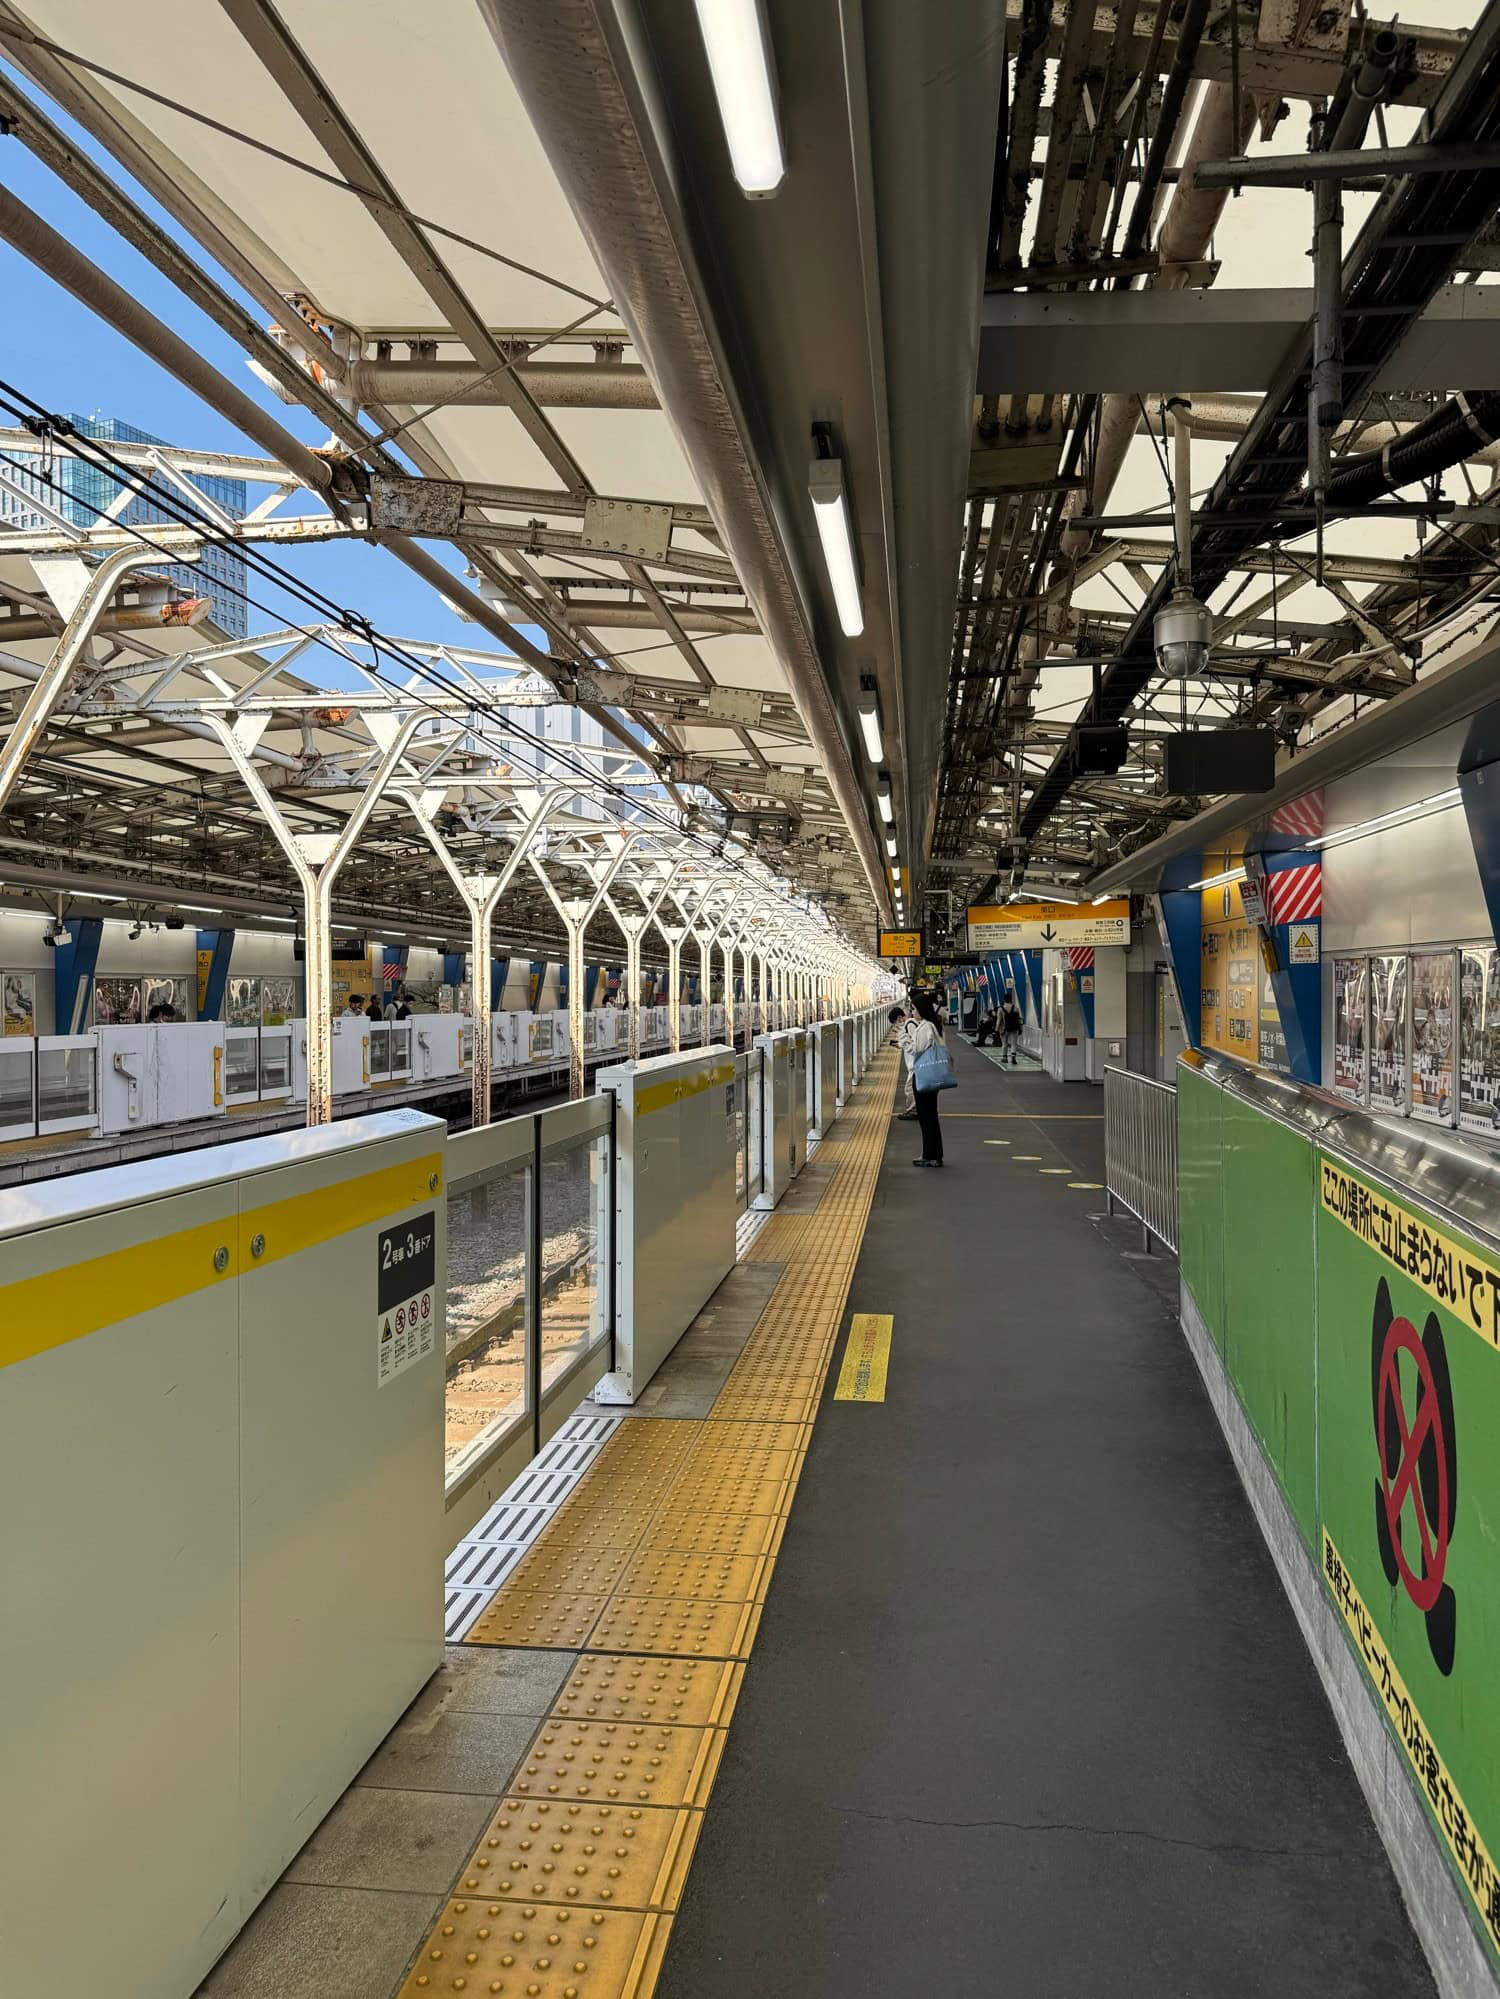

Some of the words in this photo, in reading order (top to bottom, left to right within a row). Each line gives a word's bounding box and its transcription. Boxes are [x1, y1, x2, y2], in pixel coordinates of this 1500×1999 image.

[382, 1238, 404, 1270] 2号車
[406, 1233, 431, 1258] 3番ドア
